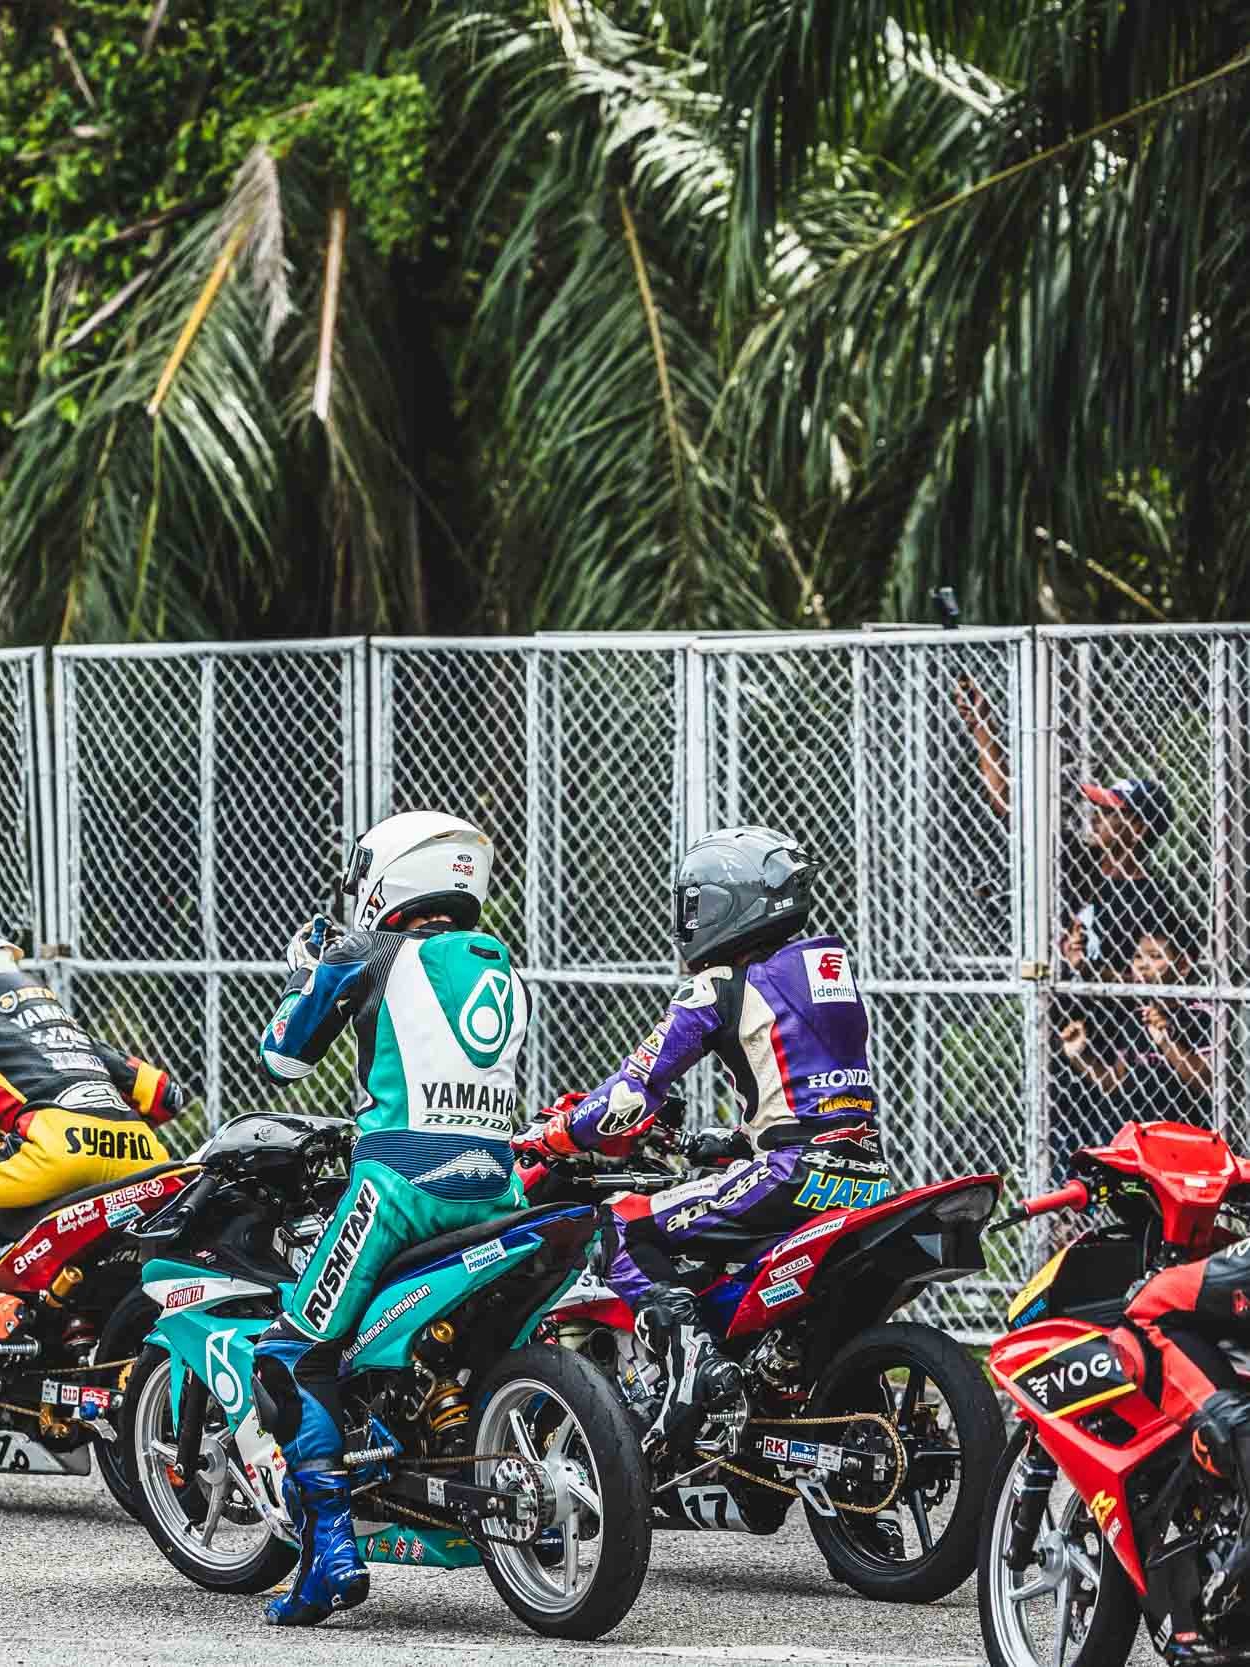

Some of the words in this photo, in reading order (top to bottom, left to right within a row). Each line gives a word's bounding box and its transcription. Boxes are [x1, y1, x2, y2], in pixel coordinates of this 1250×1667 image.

[422, 1082, 514, 1117] YAMAHA
[104, 1185, 146, 1206] BRISK
[25, 1238, 53, 1264] RCB
[466, 1242, 499, 1261] PETRONAS
[468, 1251, 503, 1271] PRIMAX
[772, 1258, 810, 1278] RAKUDA
[167, 1286, 203, 1307] SPRINTA
[761, 1281, 794, 1297] PETRONAS
[766, 1288, 799, 1306] PRIMAX
[358, 1316, 388, 1347] Memacu
[384, 1283, 431, 1323] Kemajuan
[765, 1439, 786, 1452] RK
[685, 1492, 727, 1529] 17
[395, 1539, 407, 1558] RK
